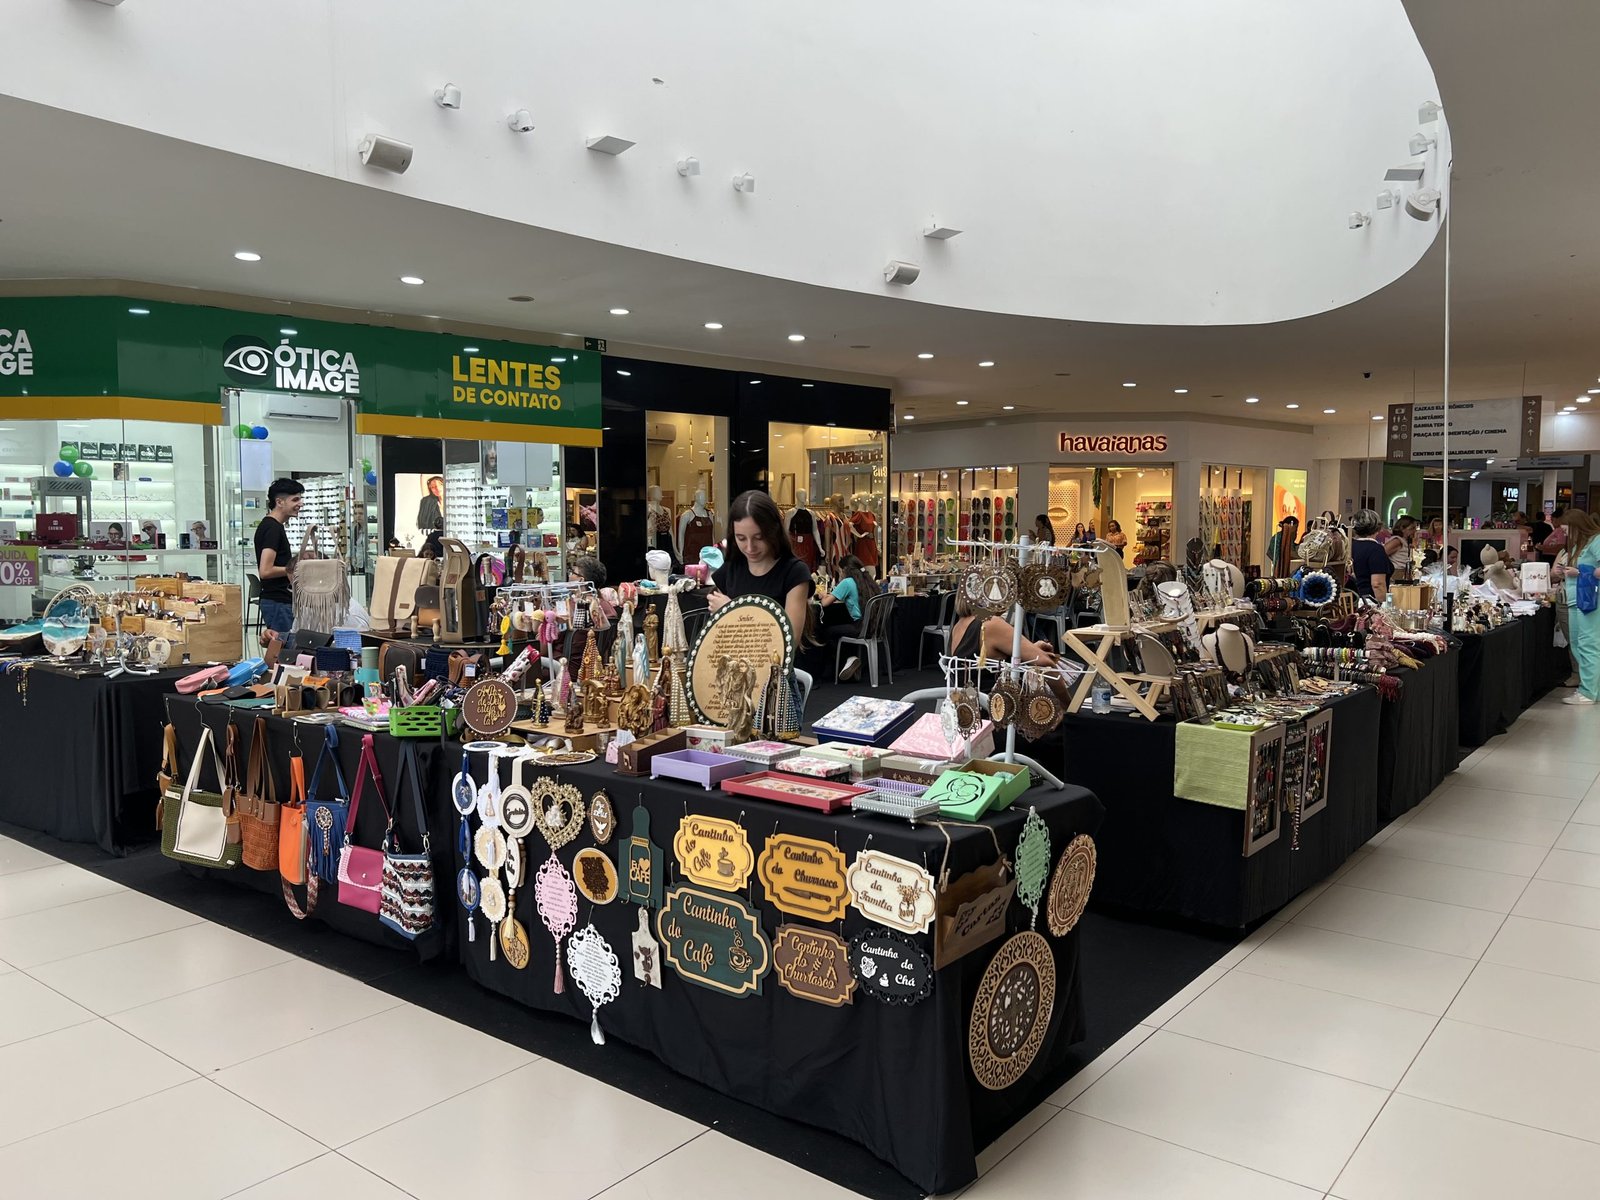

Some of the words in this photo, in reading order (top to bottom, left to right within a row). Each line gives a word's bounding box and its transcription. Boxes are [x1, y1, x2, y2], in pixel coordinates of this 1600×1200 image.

[274, 338, 360, 373] ÓTICA
[275, 366, 360, 394] IMAGE
[452, 355, 561, 390] LENTES
[453, 385, 477, 403] DE
[480, 388, 562, 411] CONTATO
[1060, 432, 1168, 454] havaianas
[14, 577, 34, 585] OFF
[692, 823, 735, 843] Cantinho
[685, 839, 696, 854] do
[784, 846, 824, 865] Cantinho
[771, 862, 784, 875] do
[794, 868, 838, 889] Churrasco
[865, 861, 902, 883] Cantinho
[870, 879, 883, 892] da
[683, 895, 737, 929] Cantinho
[667, 917, 682, 939] do
[683, 939, 715, 973] Café
[791, 935, 836, 960] Cantinho
[860, 942, 899, 959] Cantinho
[794, 950, 808, 968] do
[900, 959, 914, 971] do
[894, 973, 916, 987] Chá
